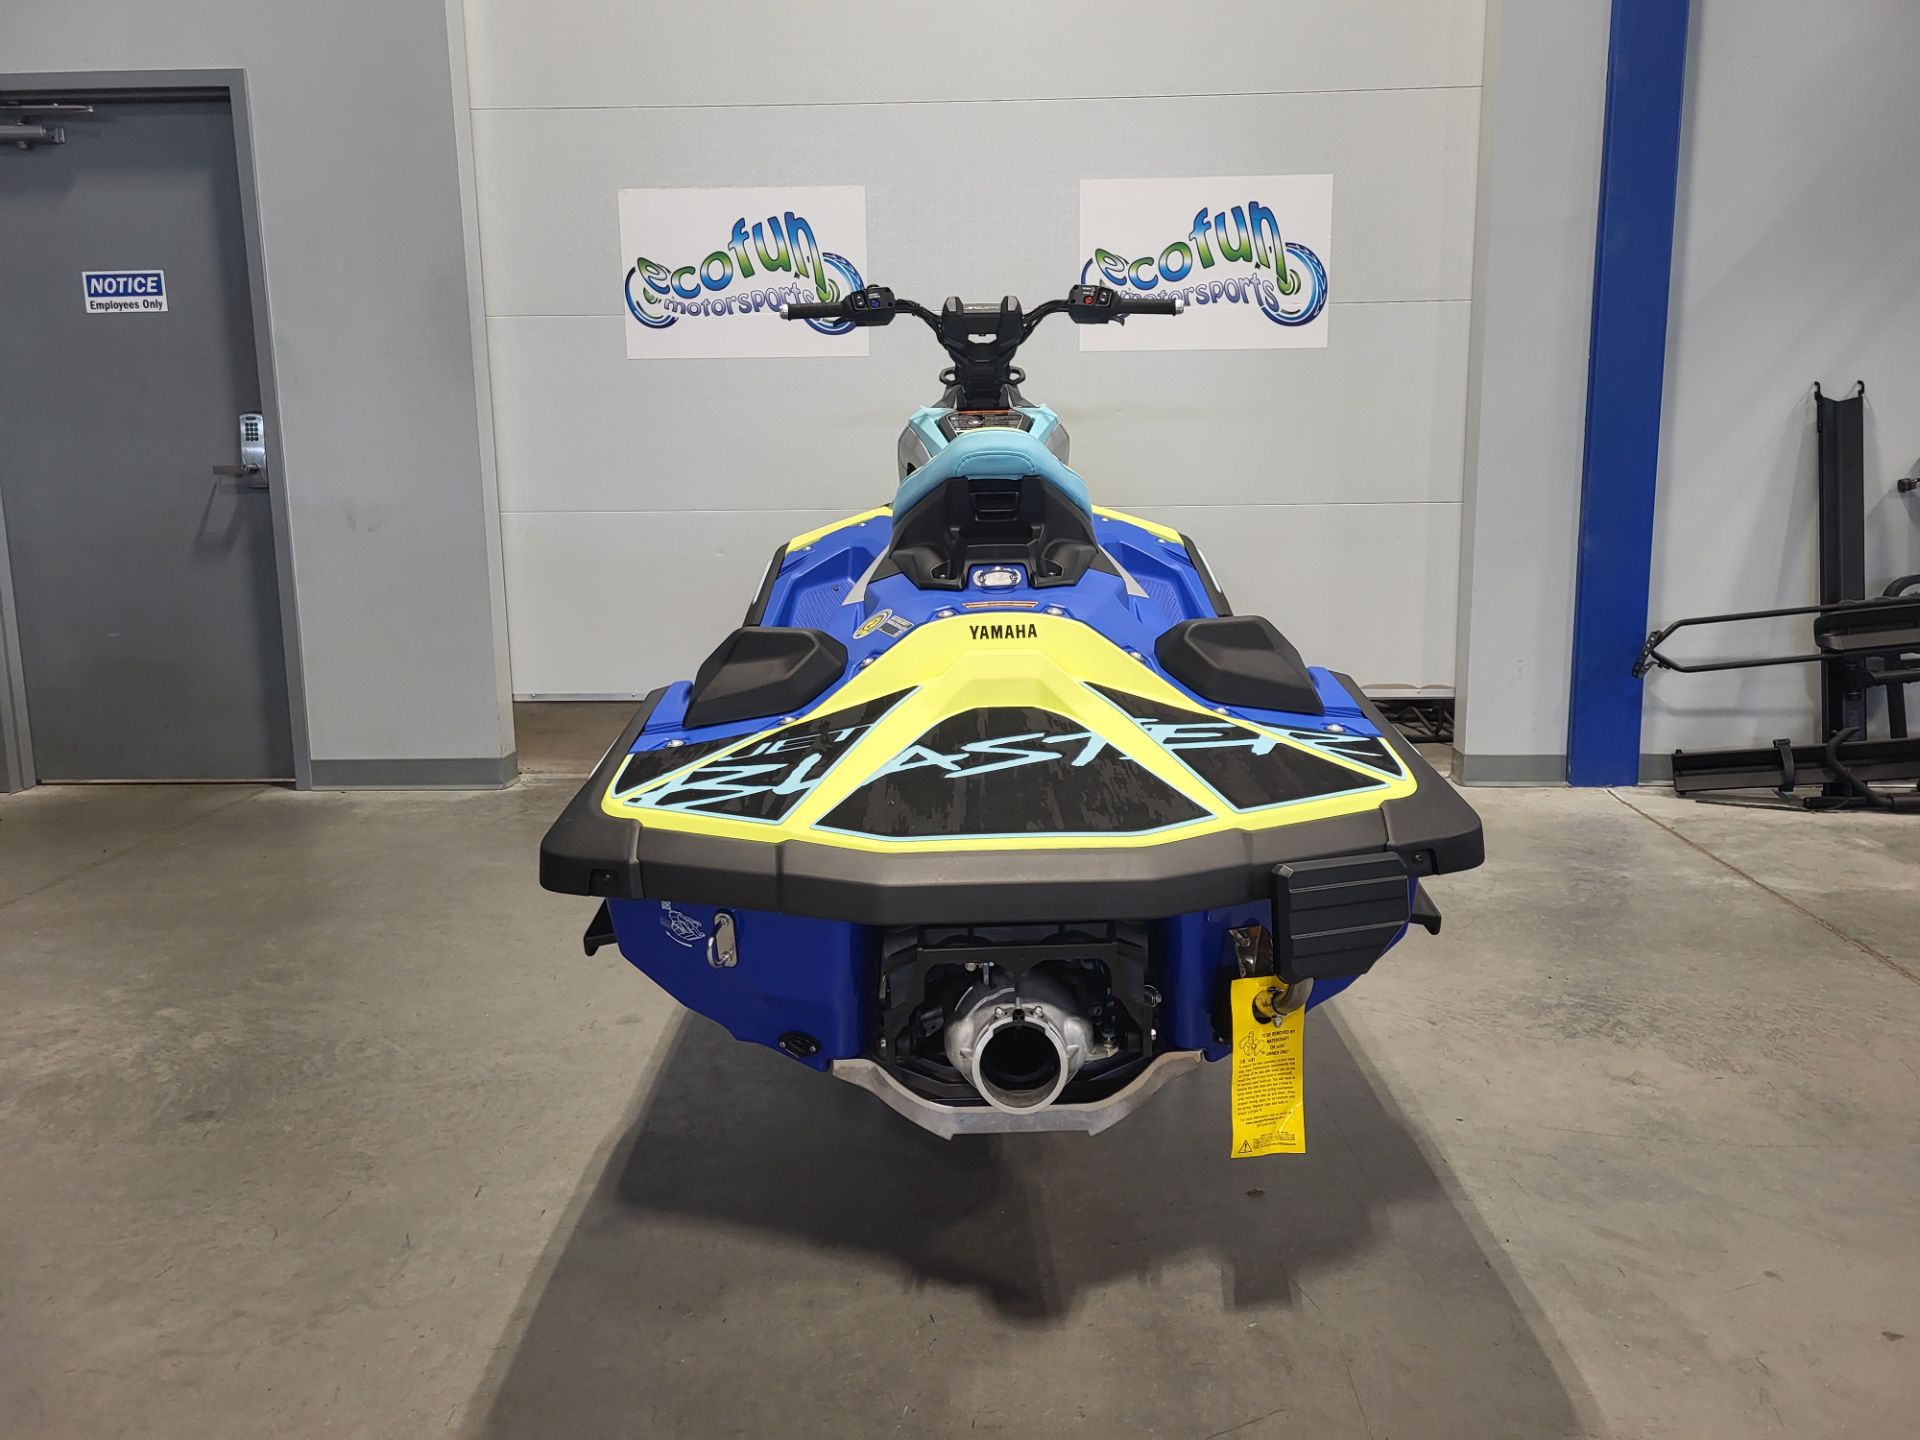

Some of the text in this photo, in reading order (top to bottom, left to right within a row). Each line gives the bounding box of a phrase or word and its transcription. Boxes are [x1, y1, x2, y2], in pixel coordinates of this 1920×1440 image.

[637, 212, 827, 299] ecofun
[1095, 201, 1288, 290] ecofun
[90, 276, 159, 294] NOTICE
[90, 299, 163, 311] Employees Only
[969, 624, 1038, 640] YAMAHA
[717, 724, 875, 761] JET
